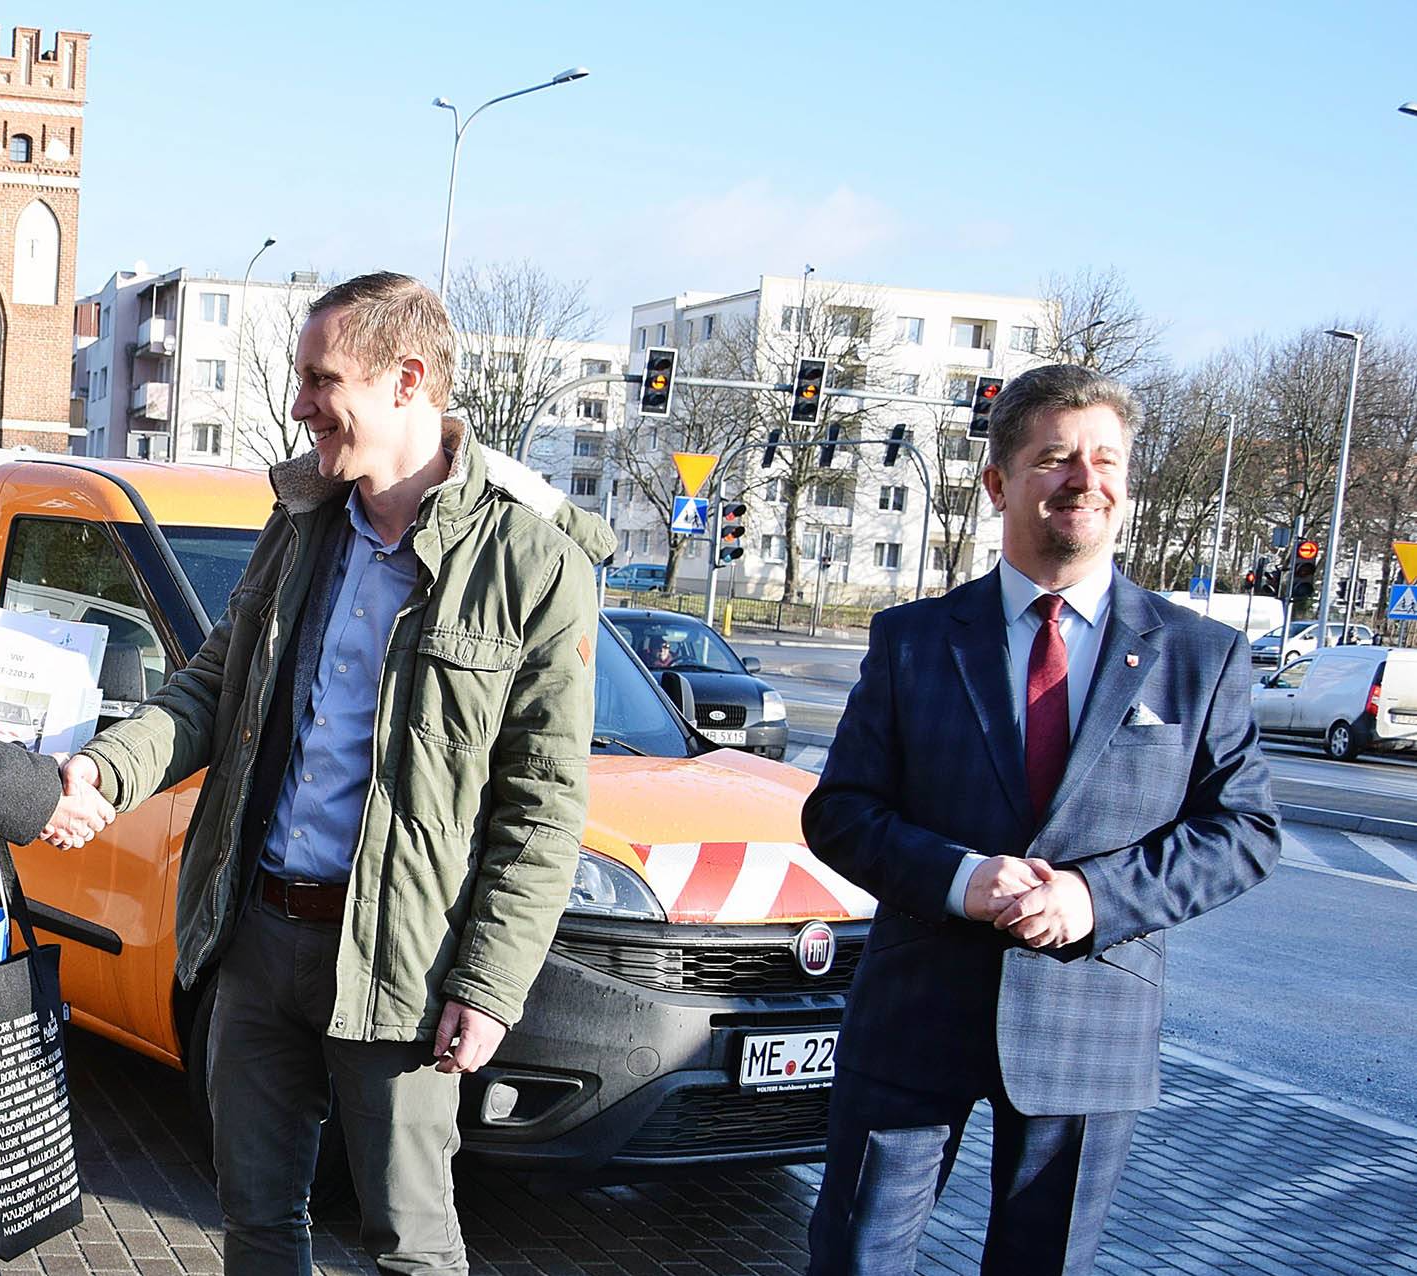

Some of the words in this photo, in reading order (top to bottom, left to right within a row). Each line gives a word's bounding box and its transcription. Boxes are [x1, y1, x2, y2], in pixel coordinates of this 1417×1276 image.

[806, 939, 829, 963] FIAT
[18, 1057, 48, 1077] MALBORK
[748, 1041, 785, 1077] ME
[800, 1037, 835, 1074] 22
[30, 1145, 59, 1167] MALBORK
[3, 1216, 33, 1237] MALBORK
